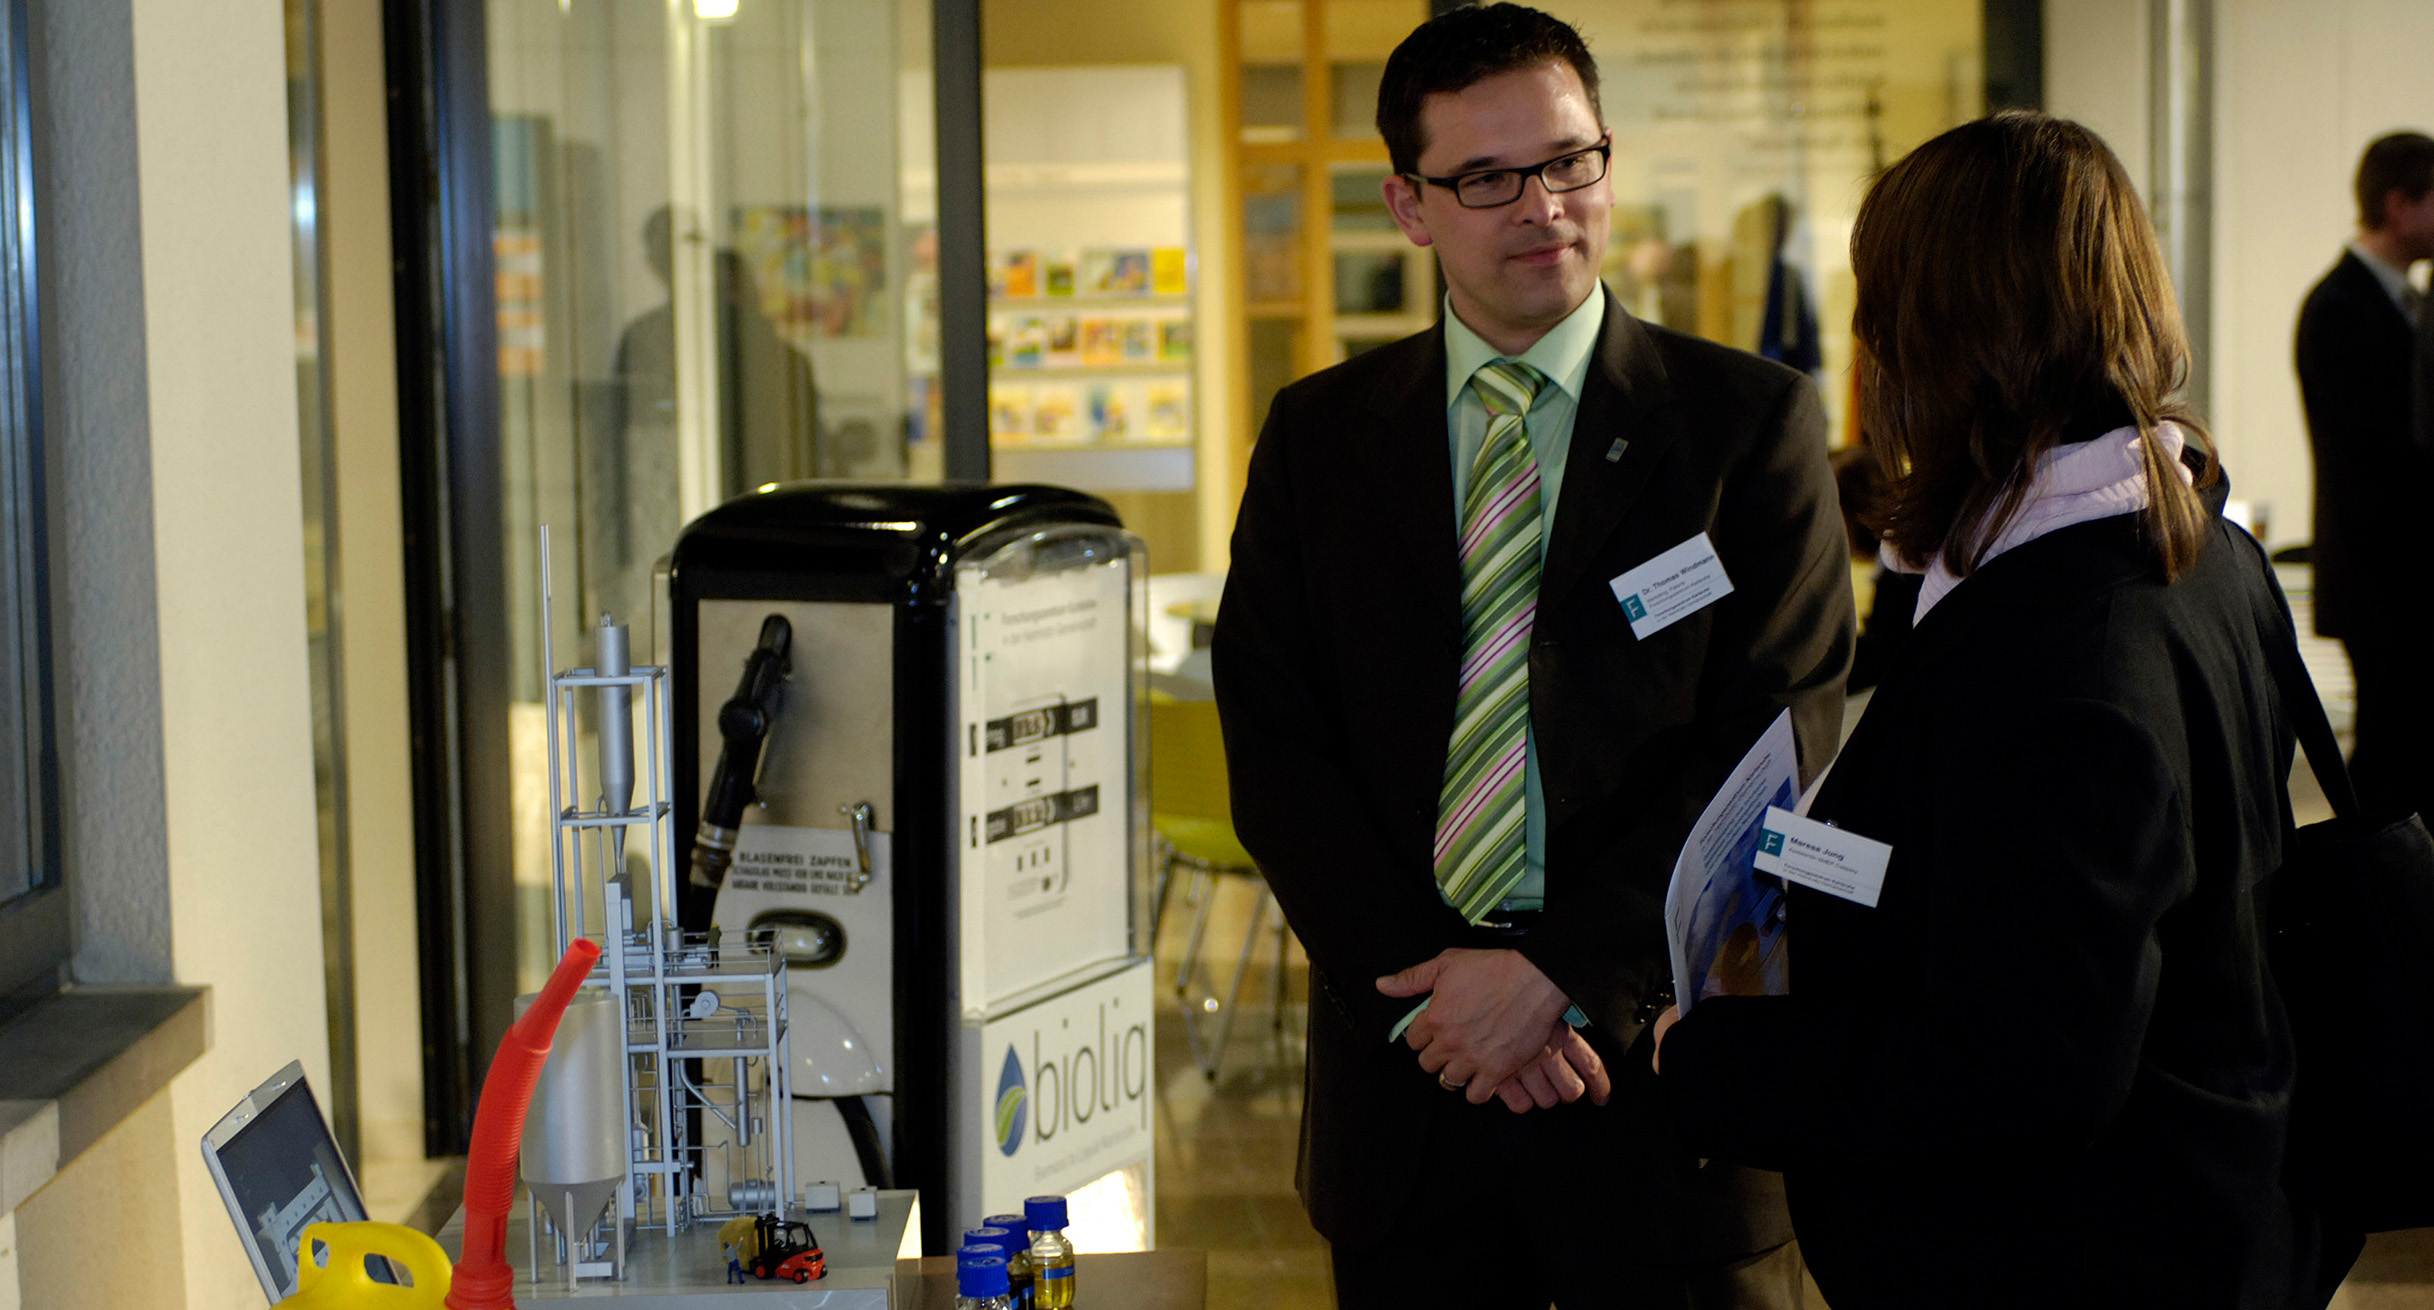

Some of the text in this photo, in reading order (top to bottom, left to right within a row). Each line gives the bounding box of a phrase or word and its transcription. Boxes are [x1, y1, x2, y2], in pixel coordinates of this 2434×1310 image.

[1652, 573, 1681, 590] Thomas
[809, 855, 851, 868] ZAPFEN
[1822, 848, 1846, 862] Jung
[1034, 997, 1147, 1145] bioliq
